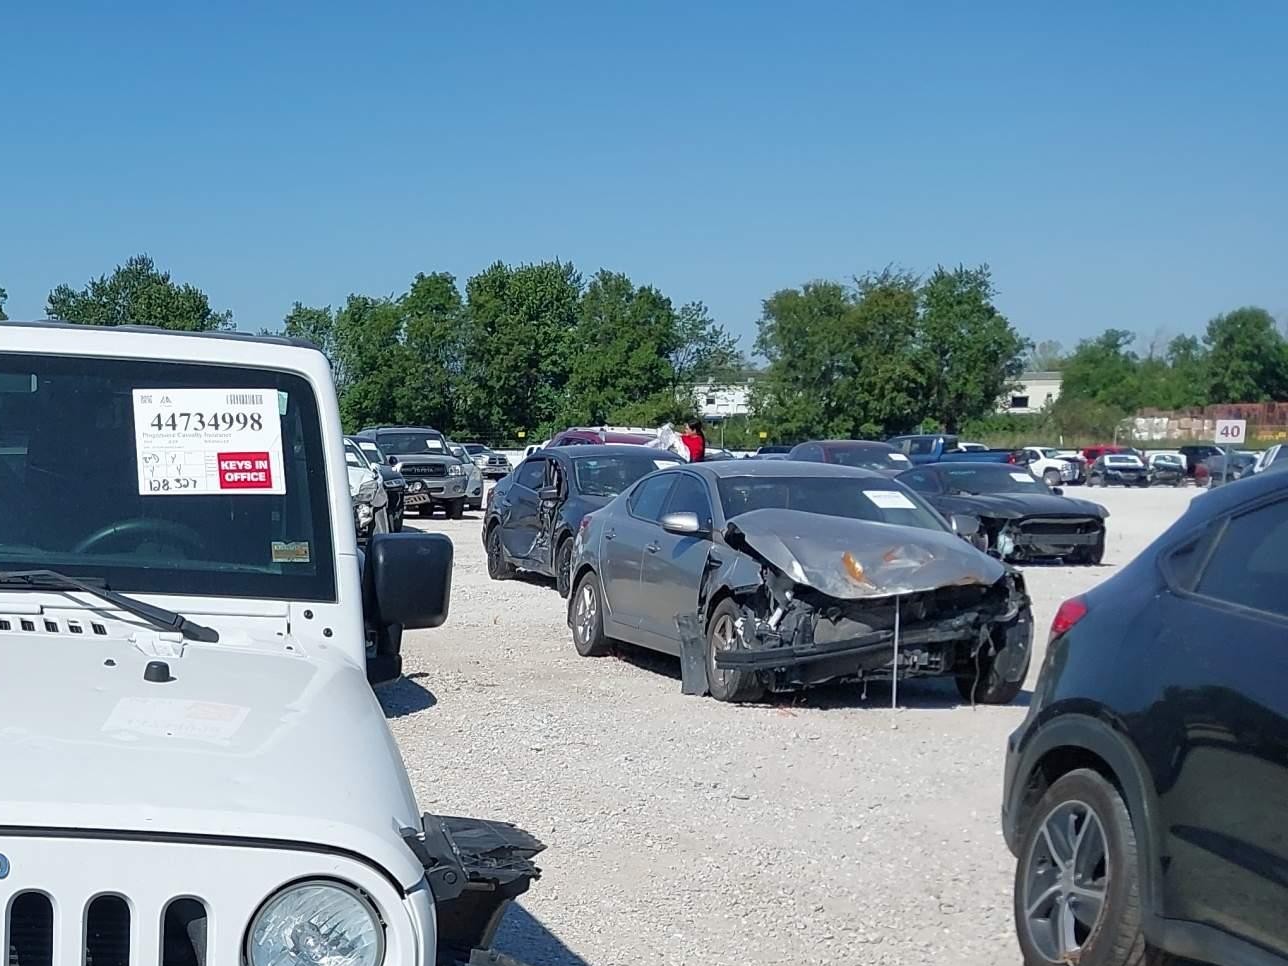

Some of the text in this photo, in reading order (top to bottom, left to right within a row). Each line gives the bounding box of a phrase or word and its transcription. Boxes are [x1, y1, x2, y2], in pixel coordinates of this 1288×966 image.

[150, 412, 263, 432] 44734998
[1220, 425, 1240, 438] 40
[220, 460, 253, 470] KEYS
[255, 460, 268, 470] IN
[225, 472, 267, 483] OFFICE
